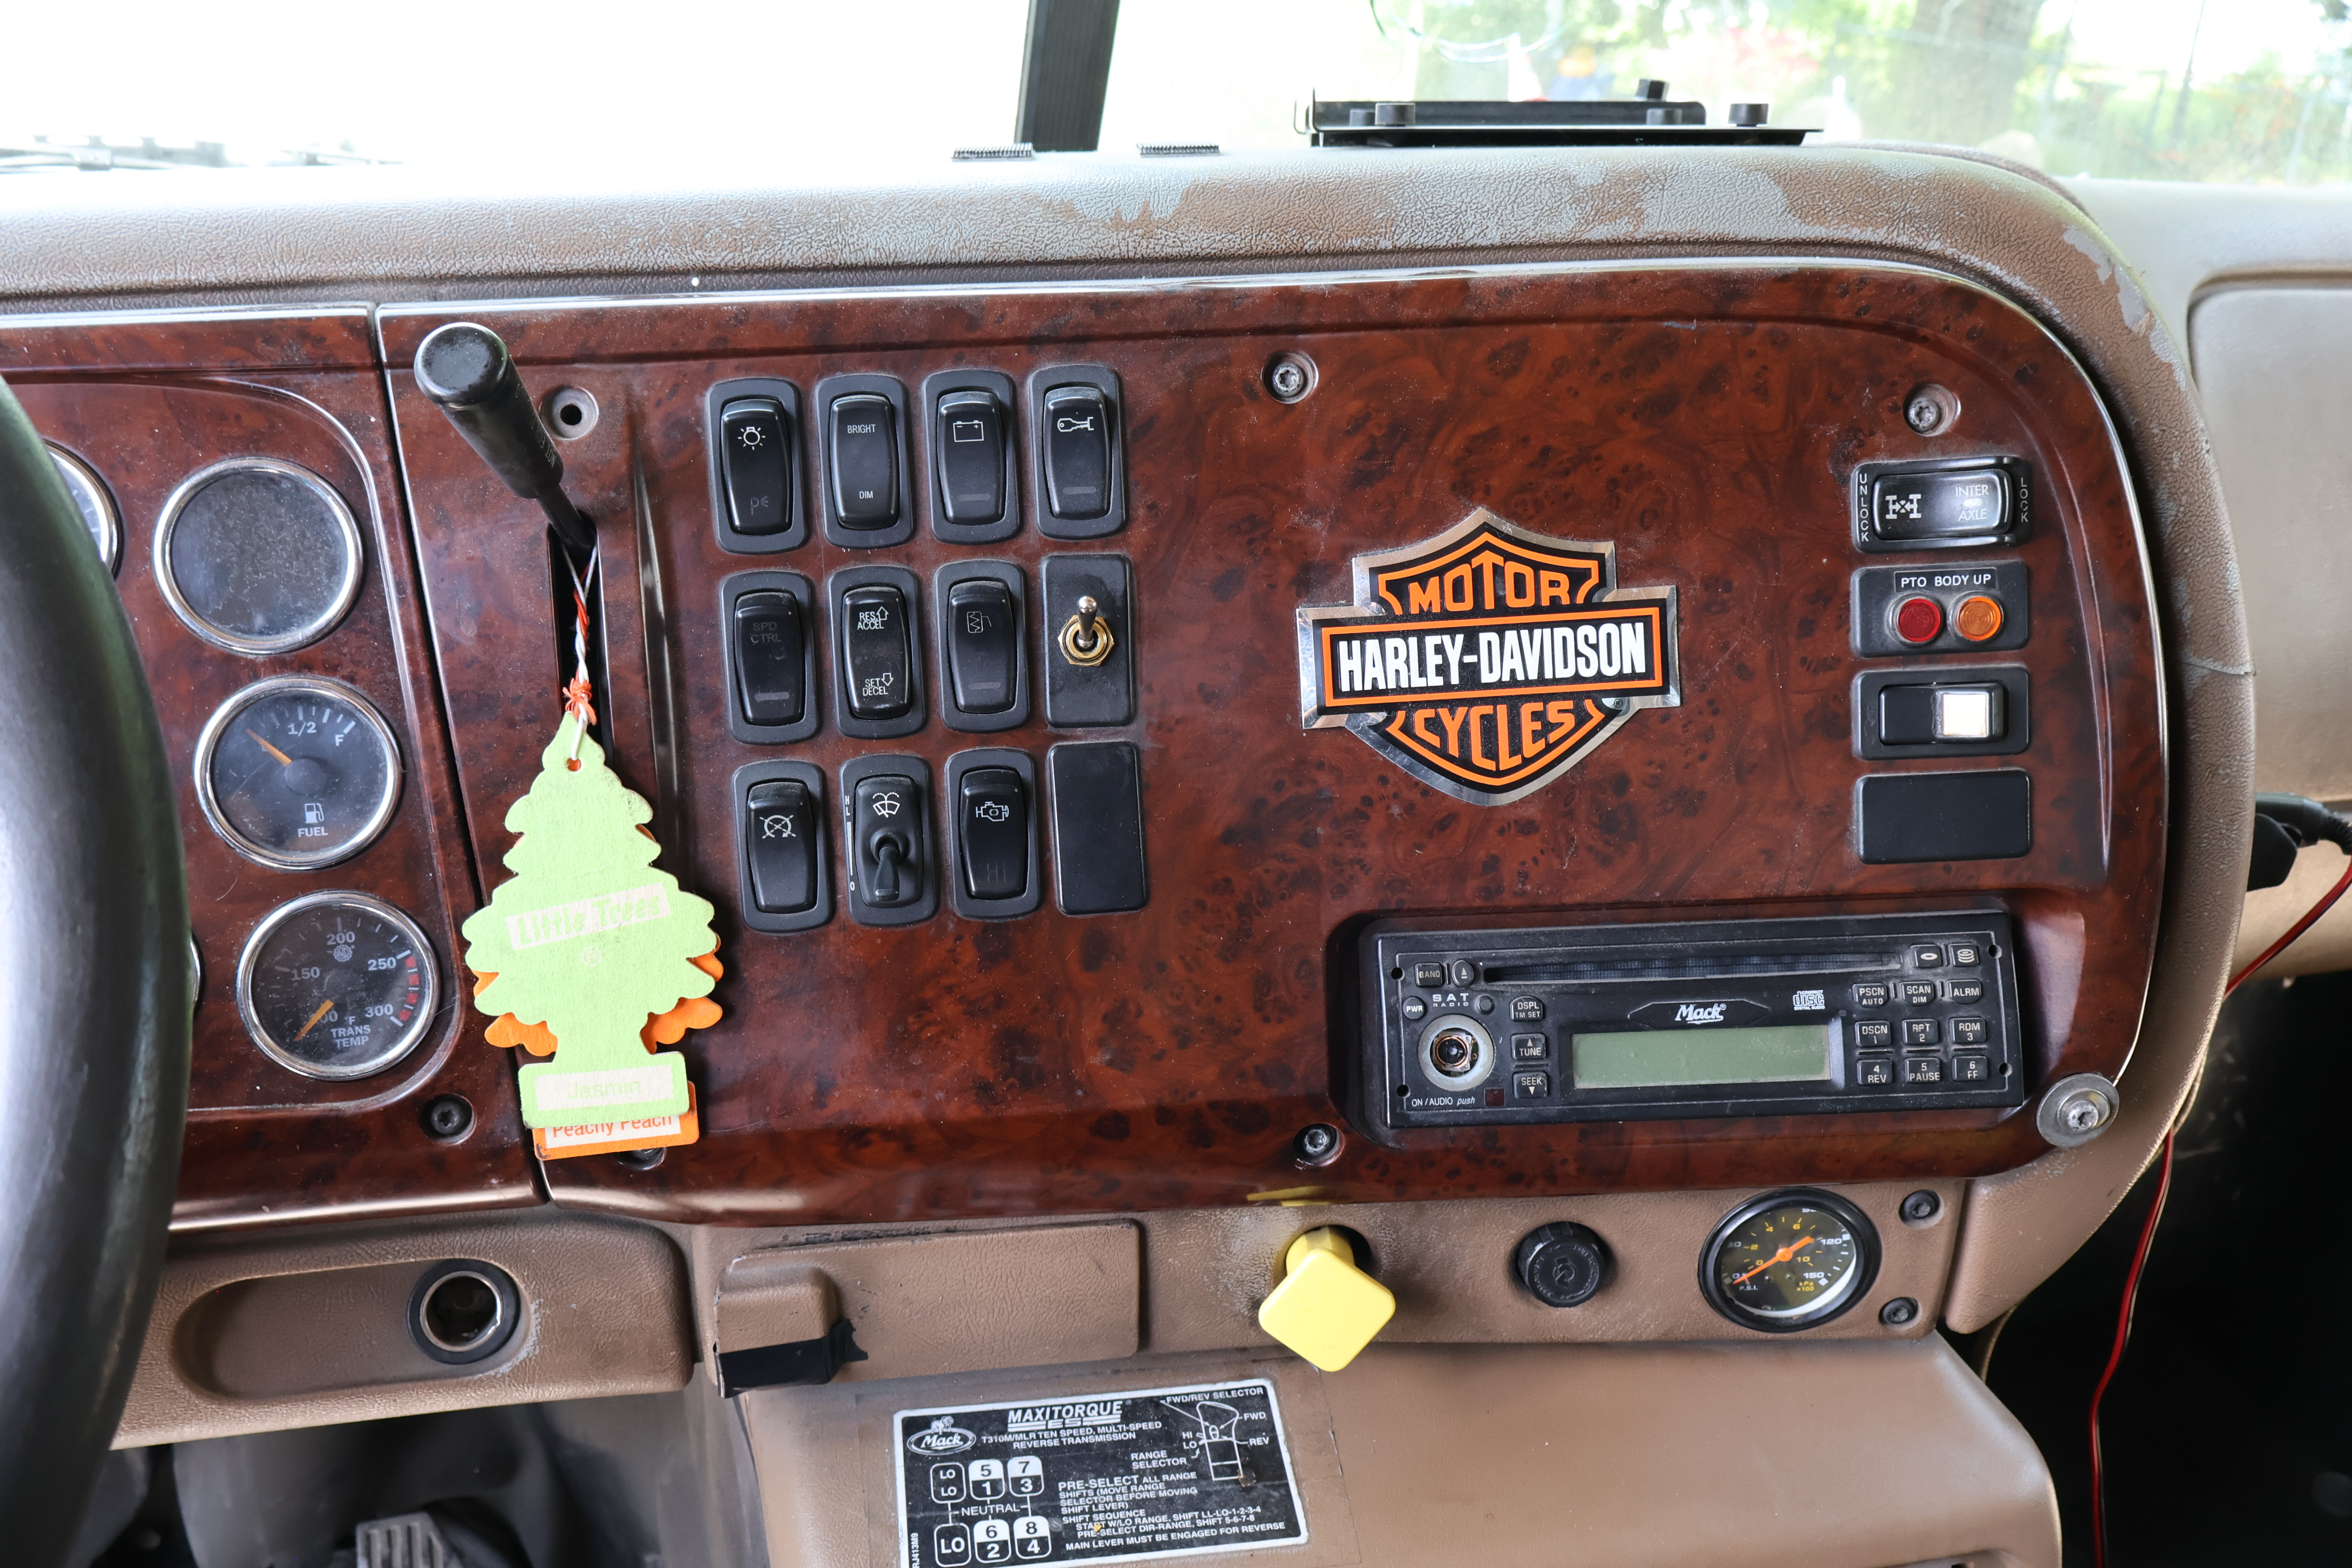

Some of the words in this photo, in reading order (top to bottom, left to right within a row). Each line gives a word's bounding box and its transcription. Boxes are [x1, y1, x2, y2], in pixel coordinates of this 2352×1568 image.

[847, 424, 876, 434] BRIGHT
[859, 491, 873, 499] DIM
[1955, 484, 1989, 497] INTER
[2020, 477, 2028, 523] LOCK
[1859, 473, 1869, 542] UNLOCK
[1958, 508, 1987, 521] AXLE
[1408, 550, 1570, 614] MOTOR
[1901, 577, 1927, 588] PTO
[1934, 575, 1969, 586] BODY
[1973, 573, 1991, 585] UP
[859, 612, 878, 621] RES.
[857, 620, 884, 630] ACCEL
[1338, 622, 1646, 692] HARLEY-DAVIDSON
[865, 678, 880, 688] SET
[862, 686, 888, 696] DECEL
[288, 722, 317, 737] 1/2
[1414, 699, 1576, 771] CYCLES
[334, 734, 344, 746] F
[298, 826, 328, 838] FUEL
[516, 907, 585, 944] Little
[592, 895, 662, 928] Trees
[326, 931, 356, 945] 200
[367, 957, 396, 971] 250
[291, 967, 320, 981] 150
[1419, 970, 1441, 978] BAND
[1859, 988, 1884, 996] PSCN
[1906, 985, 1931, 994] SCAN
[1953, 987, 1980, 996] ALRM
[1432, 993, 1469, 1002] SAT
[365, 1004, 394, 1018] 300
[1517, 1002, 1539, 1010] DSPL
[1675, 1004, 1724, 1022] Mack
[330, 1024, 371, 1038] TRANS
[1862, 1025, 1888, 1034] DSCN
[1912, 1024, 1930, 1033] RPT
[1958, 1022, 1980, 1031] RDM
[335, 1035, 369, 1049] TEMP
[1919, 1033, 1926, 1042] 2
[1967, 1033, 1973, 1041] 3
[1519, 1047, 1542, 1056] TUNE
[1873, 1065, 1880, 1073] 4
[1921, 1063, 1927, 1071] 5
[1969, 1061, 1976, 1069] 6
[1521, 1077, 1542, 1086] SEEK
[1867, 1074, 1887, 1083] REV
[1909, 1072, 1940, 1081] PAUSE
[568, 1079, 642, 1100] Jasmin
[1457, 1096, 1475, 1106] push
[1166, 1393, 1210, 1404] FWD/REV
[1213, 1387, 1264, 1399] SELECTOR
[1007, 1400, 1123, 1423] MAXITORQUE
[1243, 1412, 1266, 1421] FWD
[981, 1432, 1036, 1444] T310M/MLR
[1037, 1430, 1058, 1439] TEN
[1059, 1427, 1096, 1437] SPEED,
[1097, 1421, 1162, 1434] MULTI-SPEED
[1182, 1431, 1193, 1439] HI
[920, 1433, 964, 1448] Mack
[1013, 1438, 1060, 1450] REVERSE
[1061, 1432, 1136, 1445] TRANSMISSION
[1183, 1441, 1197, 1450] LO
[1249, 1437, 1269, 1446] REV
[1131, 1450, 1168, 1461] RANGE
[1018, 1461, 1030, 1474] 7
[1132, 1457, 1187, 1470] SELECTOR
[940, 1469, 956, 1479] LO
[980, 1464, 992, 1477] 5
[1020, 1479, 1033, 1492] 3
[1058, 1475, 1139, 1491] PRE-SELECT
[1162, 1471, 1197, 1482] RANGE
[941, 1486, 957, 1497] LO
[982, 1482, 992, 1495] 1
[1059, 1489, 1094, 1499] SHIFTS
[1096, 1485, 1129, 1497] (MOVE
[1131, 1482, 1166, 1492] RANGE
[1060, 1495, 1113, 1507] SELECTOR
[1116, 1491, 1156, 1501] BEFORE
[1159, 1487, 1198, 1497] MOVING
[961, 1503, 1021, 1516] NEUTRAL
[1061, 1505, 1090, 1515] SHIFT
[1093, 1501, 1129, 1512] LEVER)
[1062, 1514, 1091, 1524] SHIFT
[1093, 1509, 1146, 1521] SEQUENCE
[1107, 1518, 1132, 1528] W/LO
[1138, 1515, 1171, 1525] RANGE,
[1172, 1511, 1200, 1521] SHIFT
[1201, 1506, 1261, 1519] LL-LO-1-2-3-4
[985, 1525, 998, 1539] 6
[1025, 1521, 1038, 1534] 8
[1077, 1526, 1137, 1539] PRE-SELECT
[1140, 1520, 1195, 1533] DIR-RANGE,
[1196, 1517, 1223, 1527] SHIFT
[1225, 1514, 1255, 1524] 5-6-7-8
[1065, 1541, 1090, 1551] MAIN
[1093, 1538, 1124, 1548] LEVER
[1126, 1535, 1153, 1545] MUST
[1155, 1533, 1169, 1542] BE
[1171, 1528, 1218, 1540] ENGAGED
[1220, 1527, 1240, 1535] FOR
[1241, 1522, 1286, 1534] REVERSE
[940, 1537, 965, 1554] LO
[986, 1544, 1000, 1558] 2
[1027, 1539, 1040, 1554] 4
